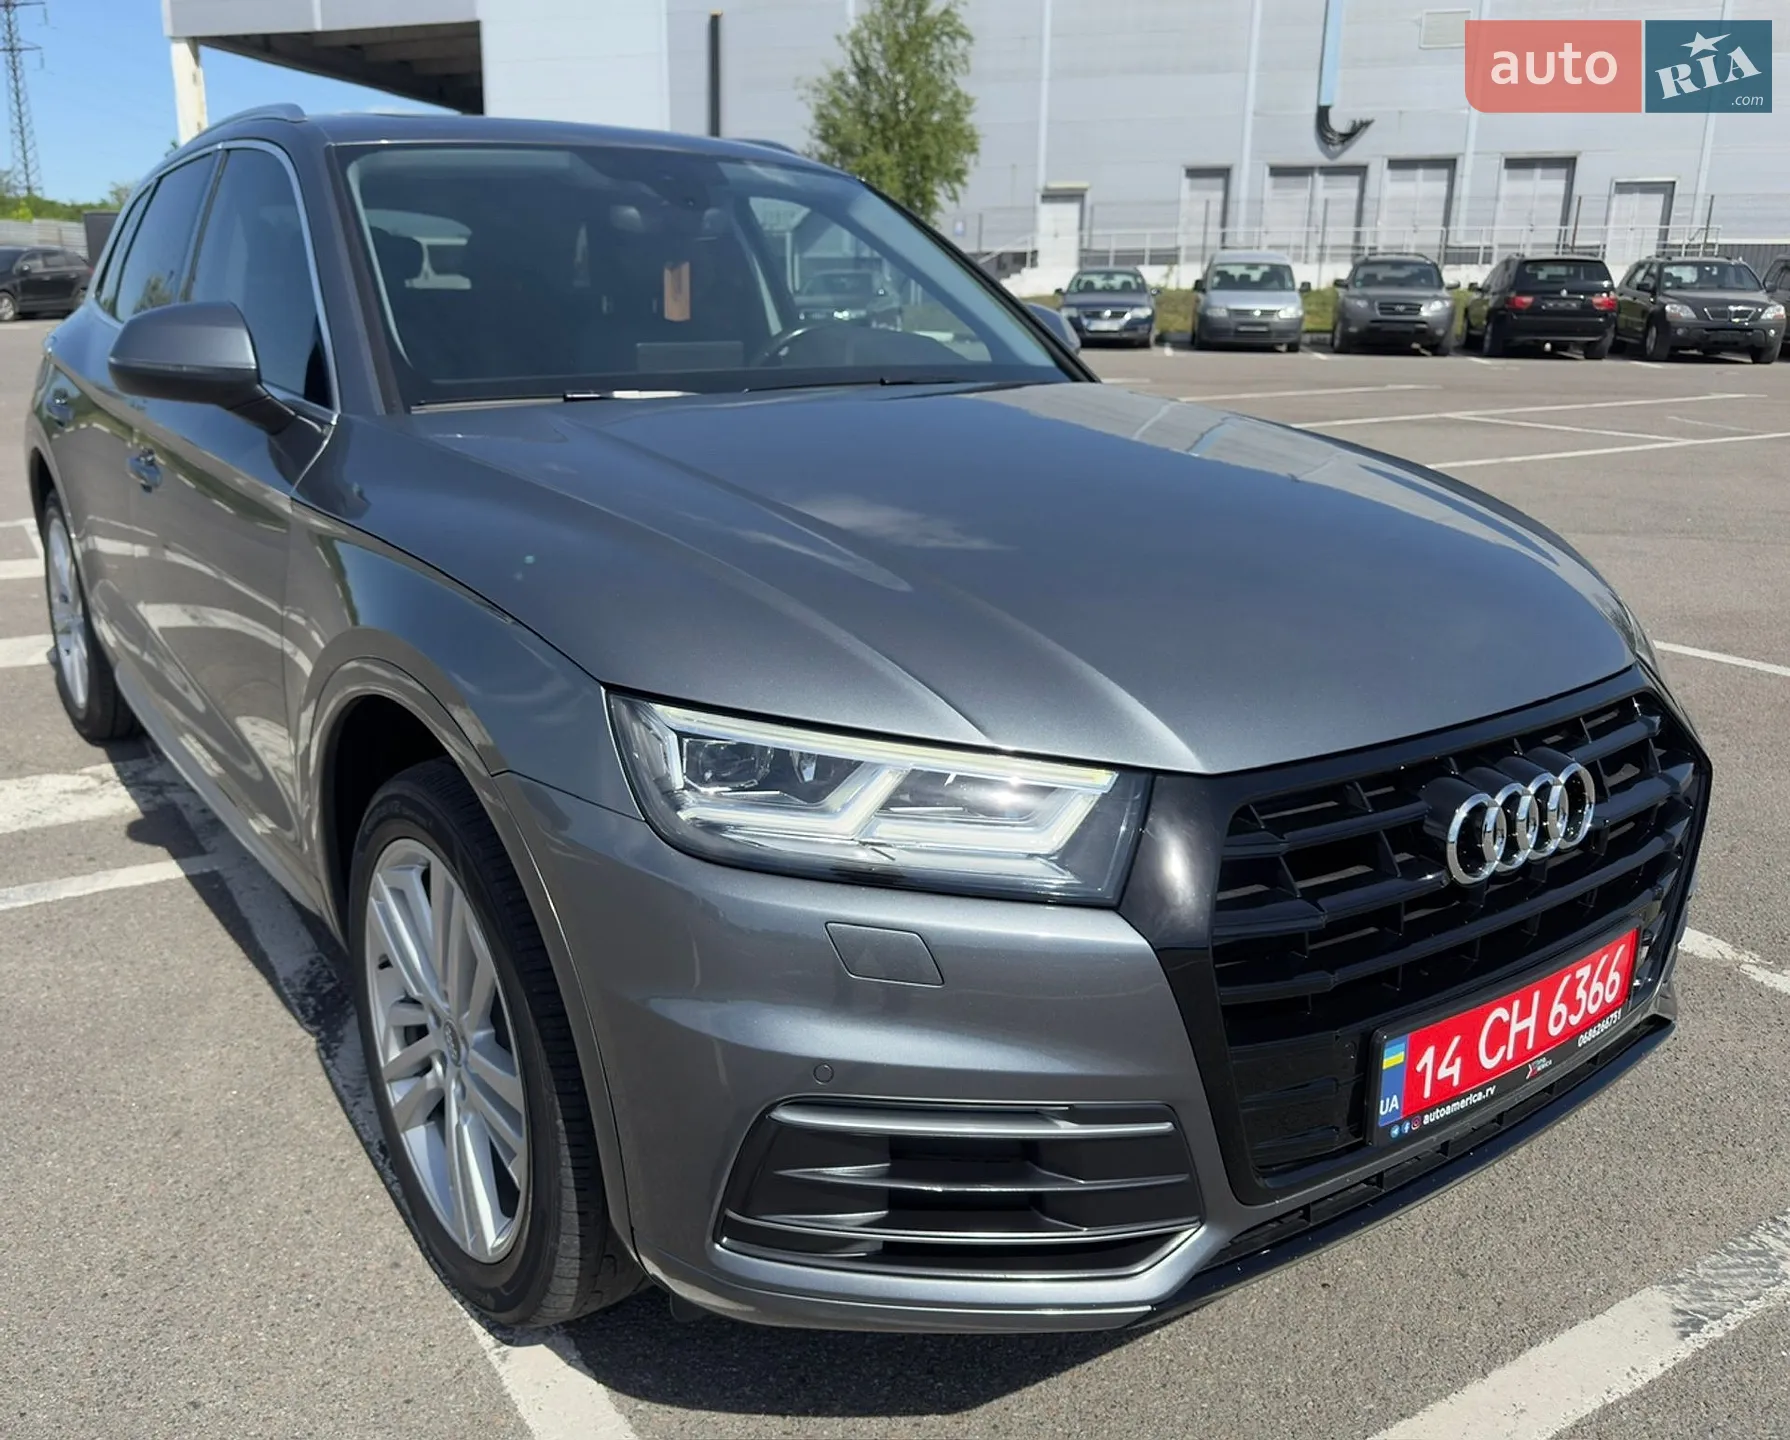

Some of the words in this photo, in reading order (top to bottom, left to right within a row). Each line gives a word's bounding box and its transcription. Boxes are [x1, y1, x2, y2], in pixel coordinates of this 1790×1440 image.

[1415, 1035, 1461, 1099] 14
[1478, 990, 1541, 1070] CH
[1548, 944, 1626, 1038] 6366
[1379, 1094, 1399, 1116] UA
[1422, 1085, 1497, 1125] autoamerica.rv
